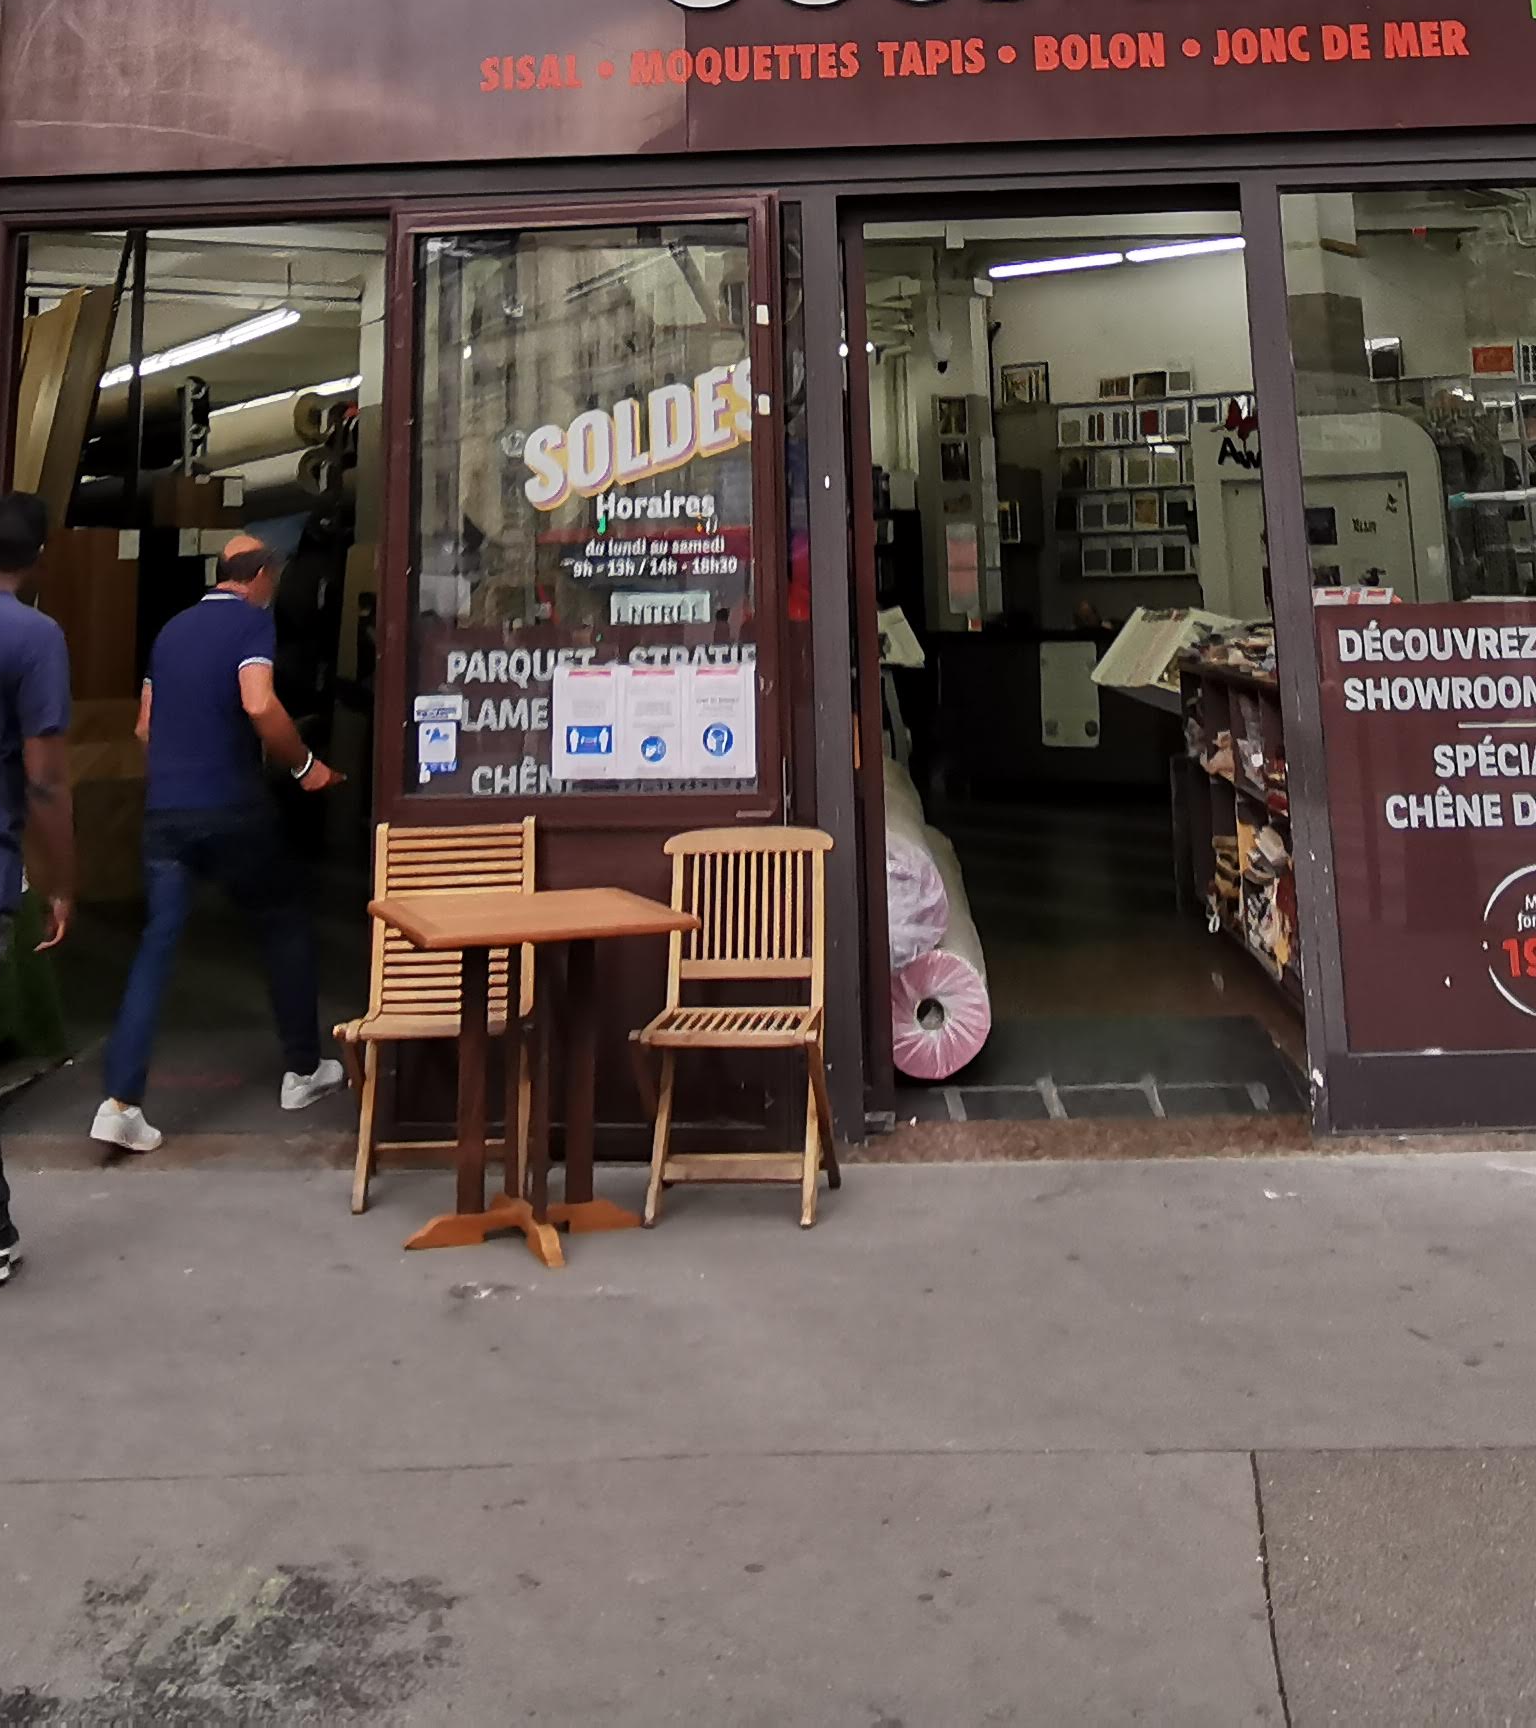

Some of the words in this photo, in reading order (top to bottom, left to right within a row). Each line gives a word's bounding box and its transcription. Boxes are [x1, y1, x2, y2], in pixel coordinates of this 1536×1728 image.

[480, 53, 582, 91] SISAL
[629, 42, 859, 86] MOQUETTES
[877, 37, 985, 76] TAPIS
[1034, 32, 1165, 71] BOLON
[1213, 26, 1310, 65] JONC
[1321, 23, 1371, 62] DE
[1383, 19, 1470, 59] MER
[596, 489, 715, 520] Horaires
[585, 537, 605, 557] du
[608, 536, 646, 556] lundi
[650, 539, 668, 555] au
[671, 535, 725, 555] samedi
[462, 697, 549, 731] LAME
[1385, 785, 1504, 829] CHÊNE
